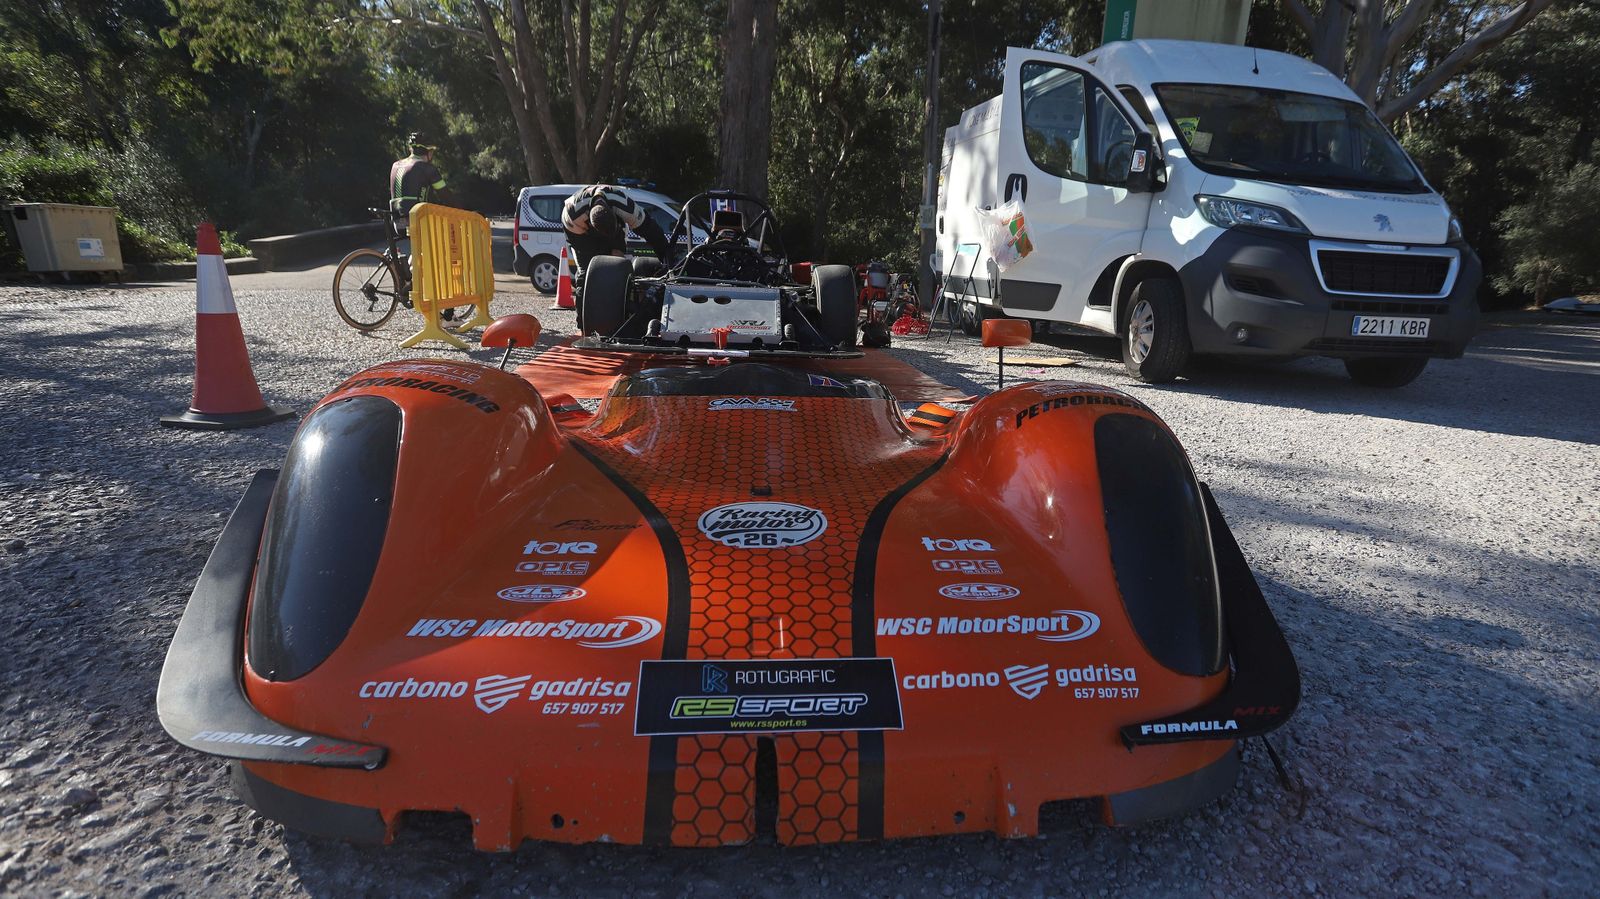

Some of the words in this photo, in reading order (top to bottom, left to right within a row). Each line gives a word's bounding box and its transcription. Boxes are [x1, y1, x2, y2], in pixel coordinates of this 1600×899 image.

[1360, 319, 1394, 334] 2211
[1400, 320, 1427, 335] KBR
[720, 508, 818, 524] Racing
[743, 533, 778, 546] 26
[406, 619, 477, 637] WSC
[472, 619, 628, 639] MotorSport
[876, 617, 933, 636] WSC
[937, 615, 1070, 634] MotorSport
[735, 669, 837, 685] ROTUGRAFIC
[903, 671, 1000, 690] carbono
[1055, 664, 1137, 687] gadrisa
[359, 677, 468, 698] carbono
[528, 677, 631, 701] gadrisa
[1074, 688, 1095, 699] 657
[1098, 688, 1119, 699] 907
[1121, 687, 1140, 698] 517
[542, 702, 569, 714] 657
[570, 702, 597, 714] 907
[599, 702, 625, 714] 517
[730, 719, 807, 729] www.rssport.es
[1141, 719, 1240, 735] FORMULA
[1233, 705, 1281, 717] MIX
[190, 731, 312, 747] FORMULA
